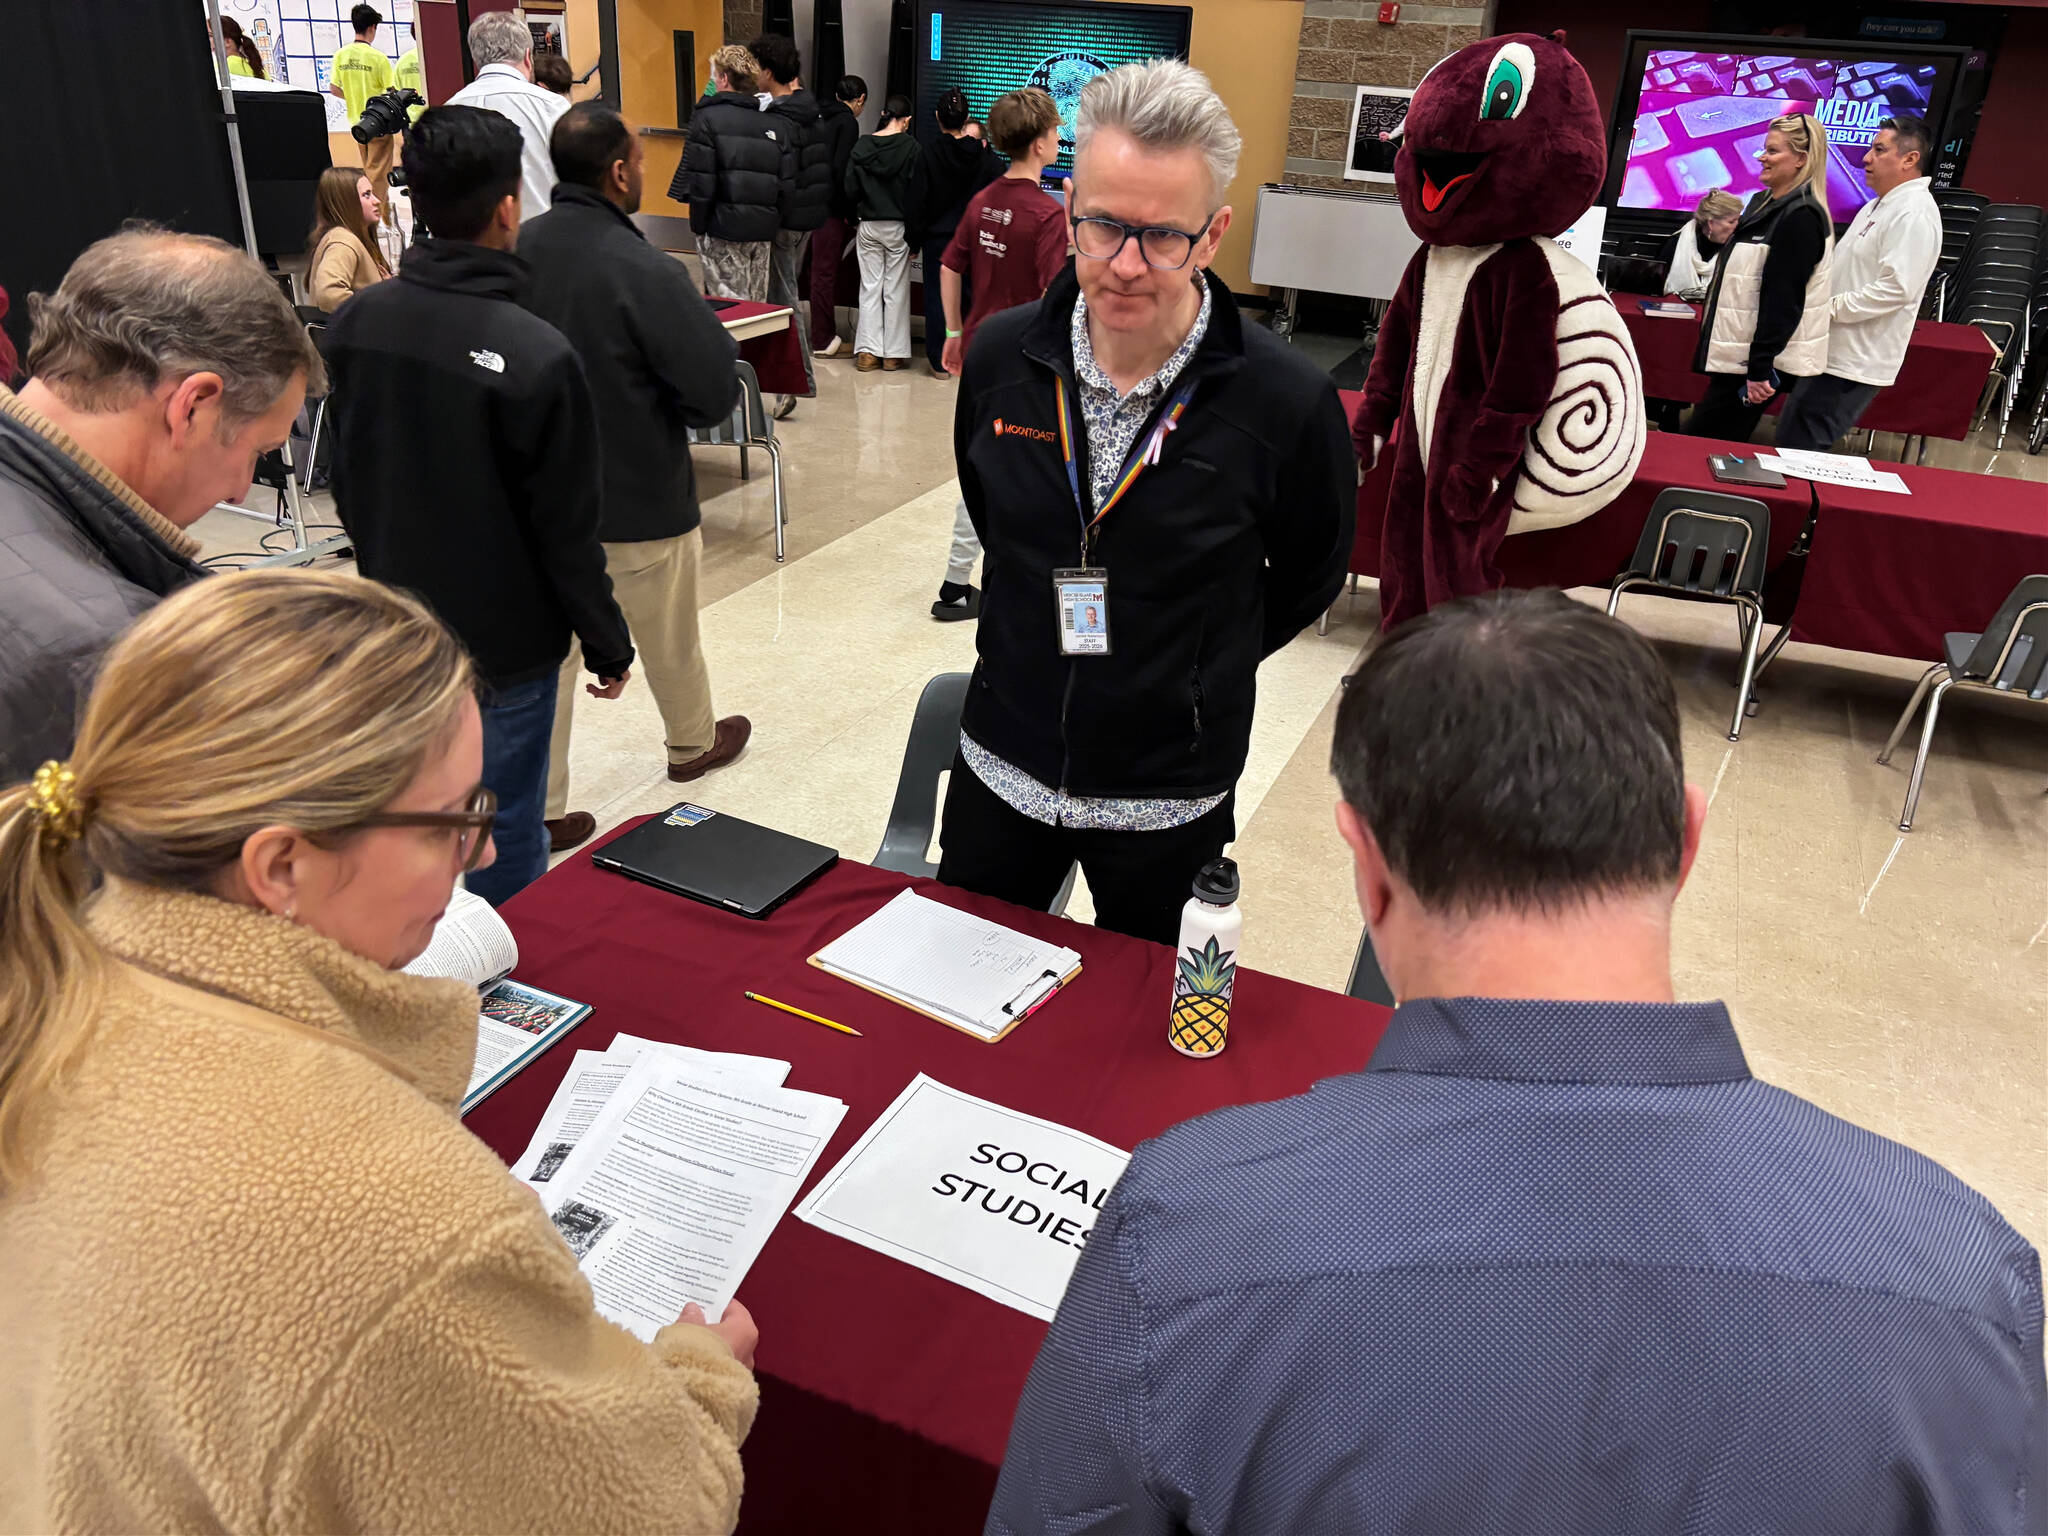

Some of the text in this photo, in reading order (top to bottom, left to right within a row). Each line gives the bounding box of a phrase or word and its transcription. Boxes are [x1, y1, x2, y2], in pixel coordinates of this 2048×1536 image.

[1900, 25, 1916, 34] you
[1814, 98, 1880, 128] MEDIA
[1005, 423, 1056, 442] MOONTOAST
[1785, 465, 1877, 484] ROBOTICS
[1804, 464, 1851, 476] CLUB
[970, 1143, 1107, 1211] SOCIAL
